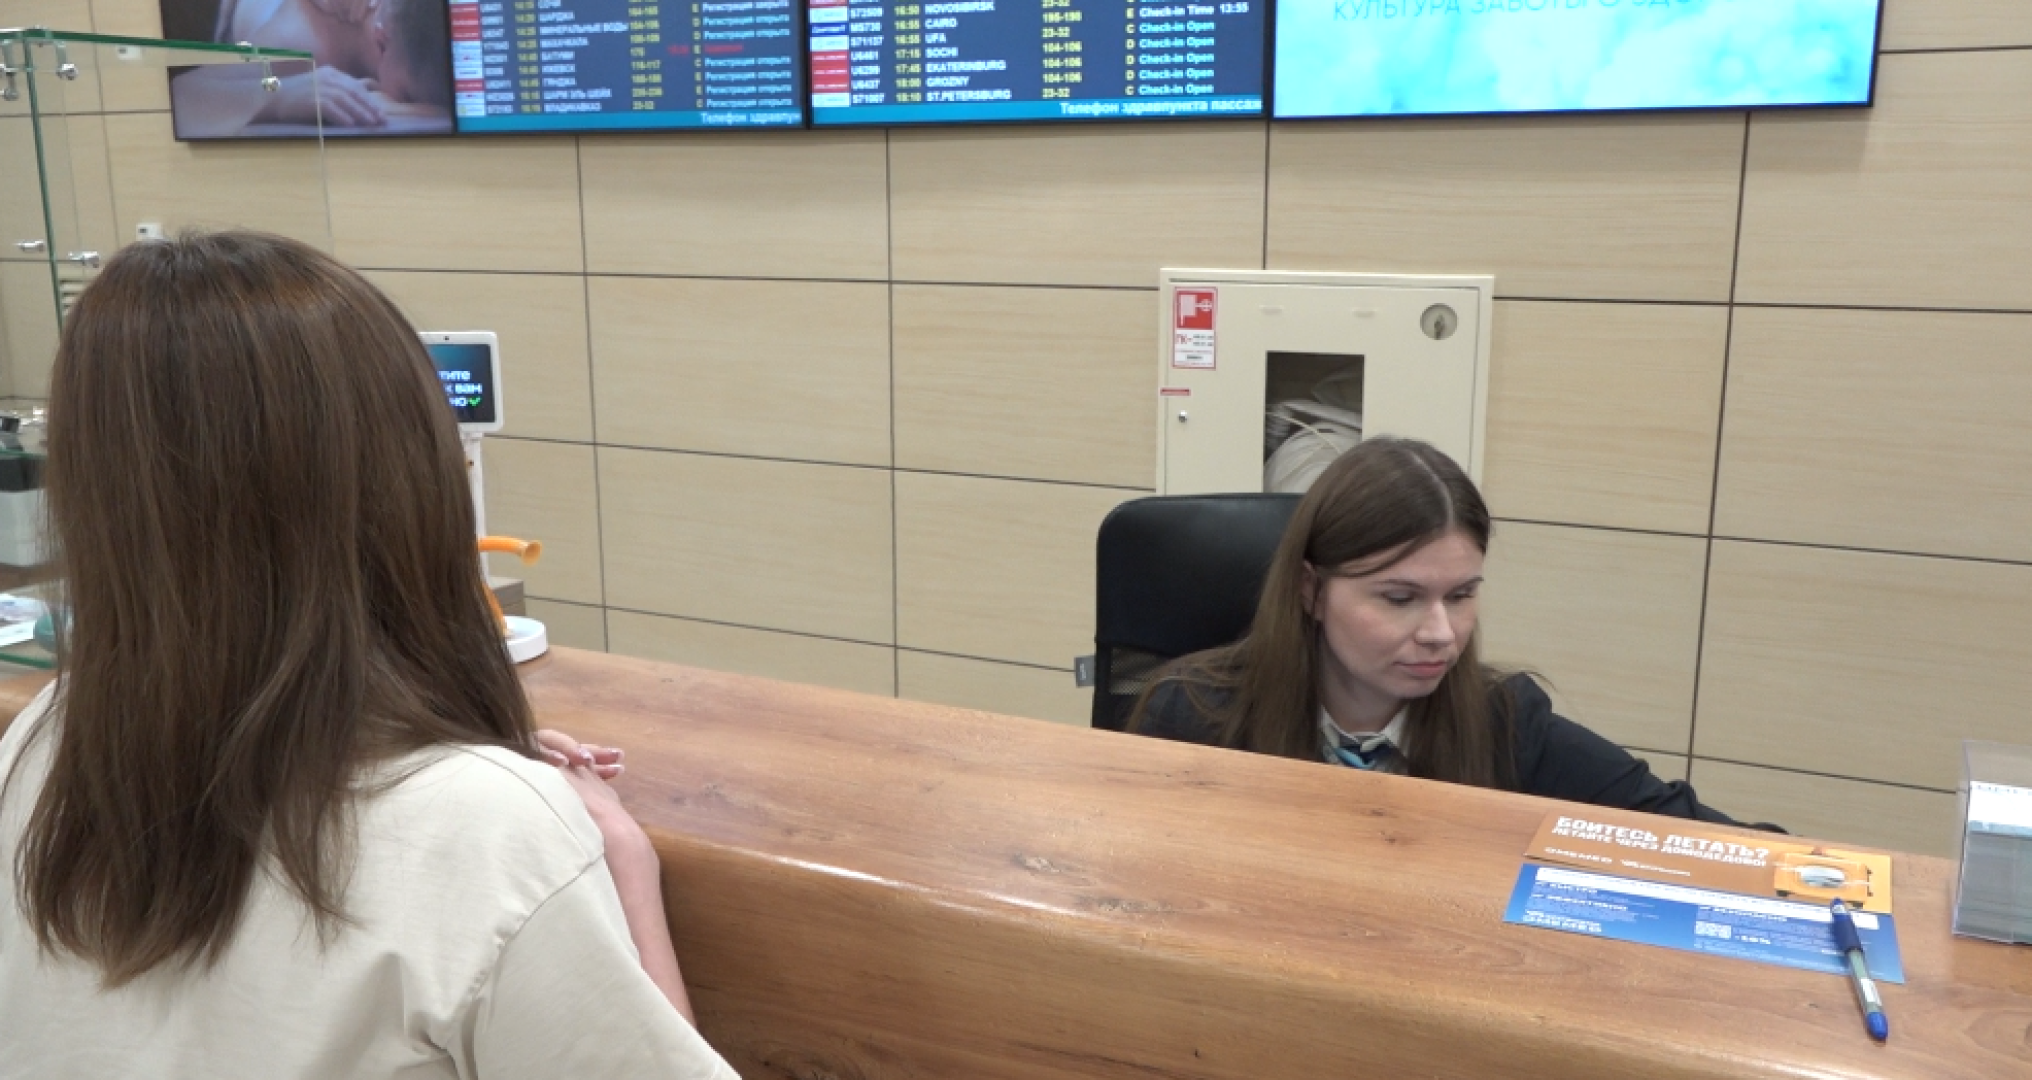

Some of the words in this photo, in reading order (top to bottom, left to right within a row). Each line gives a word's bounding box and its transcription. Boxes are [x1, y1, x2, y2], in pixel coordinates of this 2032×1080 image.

[539, 12, 575, 22] ШАРДЖА
[703, 2, 752, 12] Регистрация
[925, 1, 996, 14] NOVOSIBIRSK
[925, 18, 958, 29] CAIRO
[1140, 6, 1186, 18] Check-in
[1187, 4, 1214, 15] Time
[1220, 2, 1249, 14] 13:55
[1332, 0, 1461, 20] КУЛЬТУРА
[540, 24, 601, 36] МИНЕРАЛЬНЫЕ
[603, 22, 629, 33] ВОДЫ
[703, 16, 752, 26] Регистрация
[756, 14, 790, 24] открыта
[925, 32, 947, 44] UFA
[1126, 23, 1136, 34] C
[1140, 22, 1186, 34] Check-in
[1186, 20, 1214, 33] Open
[540, 37, 589, 48] МАХАЧКАЛА
[704, 30, 754, 40] Регистрация
[756, 29, 790, 39] открыта
[895, 49, 921, 59] 17:15
[925, 47, 958, 58] SOCHI
[1126, 38, 1136, 50] D
[1139, 36, 1185, 48] Check-in
[1186, 36, 1214, 48] Open
[542, 51, 575, 60] БАТУМИ
[542, 64, 576, 72] ИЖЕВСК
[705, 58, 754, 67] Регистрация
[757, 56, 791, 66] открыта
[895, 64, 921, 74] 17:45
[926, 60, 1006, 72] EKATERINBURG
[1126, 54, 1135, 66] D
[1139, 52, 1184, 64] Check-in
[1186, 52, 1214, 64] Open
[543, 78, 576, 88] ГЯНДЖА
[705, 72, 755, 82] Регистрация
[758, 70, 791, 80] открыта
[926, 75, 970, 88] GROZNY
[1126, 70, 1135, 80] D
[1139, 68, 1184, 80] Check-in
[1186, 67, 1214, 80] Open
[544, 90, 568, 100] ШАРМ
[587, 88, 612, 98] ШЕЙХ
[706, 85, 756, 95] Регистрация
[758, 84, 792, 94] открыта
[926, 88, 1012, 102] ST.PETERSBURG
[1126, 84, 1135, 96] C
[1138, 84, 1184, 95] Check-in
[1186, 82, 1214, 95] Open
[544, 102, 602, 112] ВЛАДИКАВКАЗ
[707, 99, 757, 108] Регистрация
[758, 98, 792, 108] открыта
[1059, 102, 1120, 116] Телефон
[1120, 101, 1209, 116] здравпункта
[701, 112, 747, 124] Телефон
[1556, 816, 1659, 842] БОИТЕСЬ
[1663, 834, 1770, 860] ЛЕТАТЬ?
[1615, 834, 1659, 850] ЧЕРЕЗ
[1660, 844, 1766, 867] ДОМОДЕДОВО!
